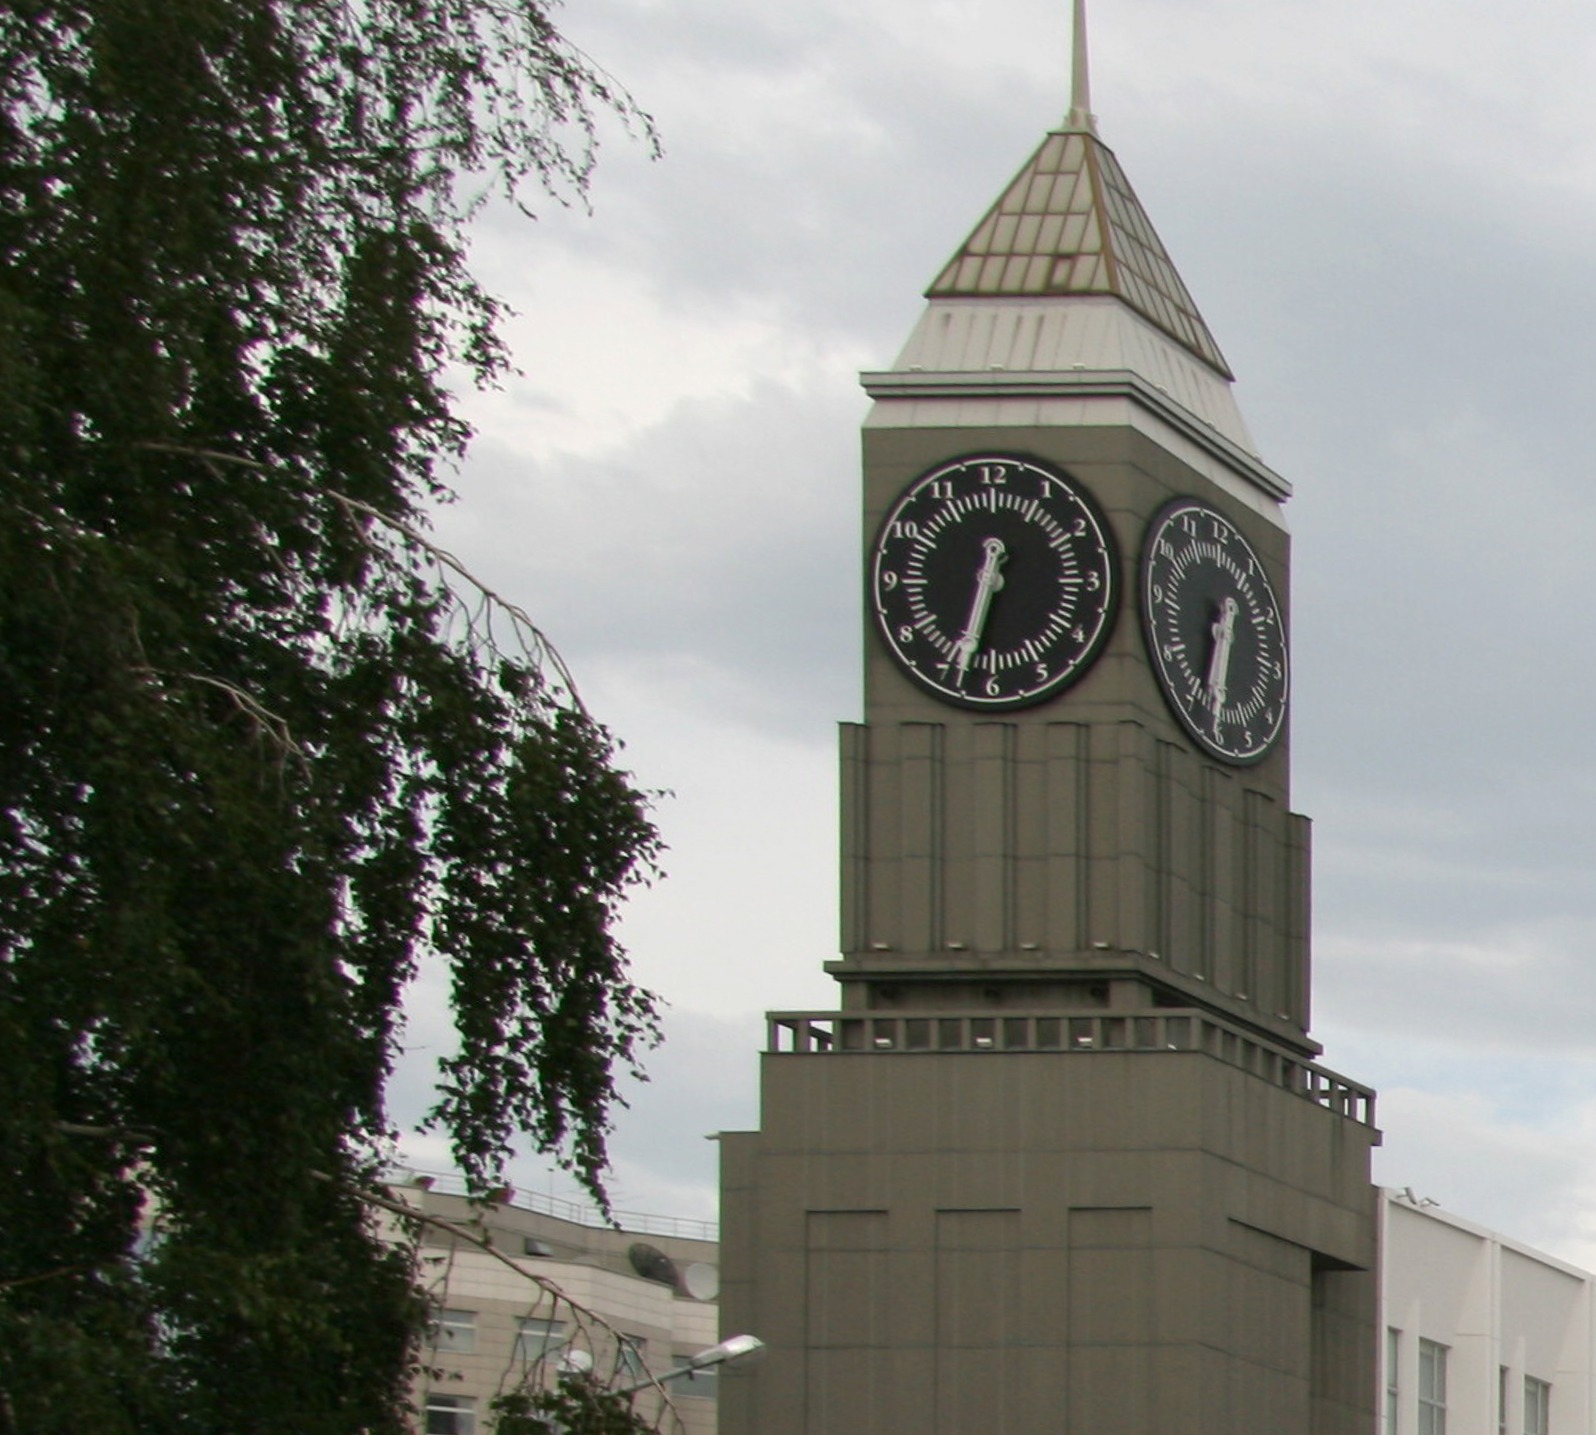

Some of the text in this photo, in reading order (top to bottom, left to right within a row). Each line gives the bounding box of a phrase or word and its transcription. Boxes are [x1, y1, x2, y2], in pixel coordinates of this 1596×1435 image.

[979, 467, 1007, 484] 12
[931, 482, 954, 499] 11
[1041, 482, 1052, 498] 1
[893, 521, 918, 538] 10
[1073, 519, 1087, 536] 2
[1183, 516, 1198, 536] 11
[1212, 522, 1228, 544] 12
[1157, 539, 1174, 560] 10
[1248, 558, 1255, 575] 1
[884, 572, 897, 590] 9
[1087, 573, 1100, 590] 3
[1153, 584, 1163, 603] 9
[1266, 608, 1275, 625] 2
[899, 626, 913, 643] 8
[1071, 626, 1085, 642] 4
[1163, 644, 1174, 661] 8
[937, 664, 950, 681] 7
[1036, 664, 1048, 682] 5
[1273, 663, 1282, 680] 3
[986, 679, 1000, 696] 6
[1185, 695, 1194, 712] 7
[1265, 708, 1274, 725] 4
[1243, 731, 1253, 748] 5
